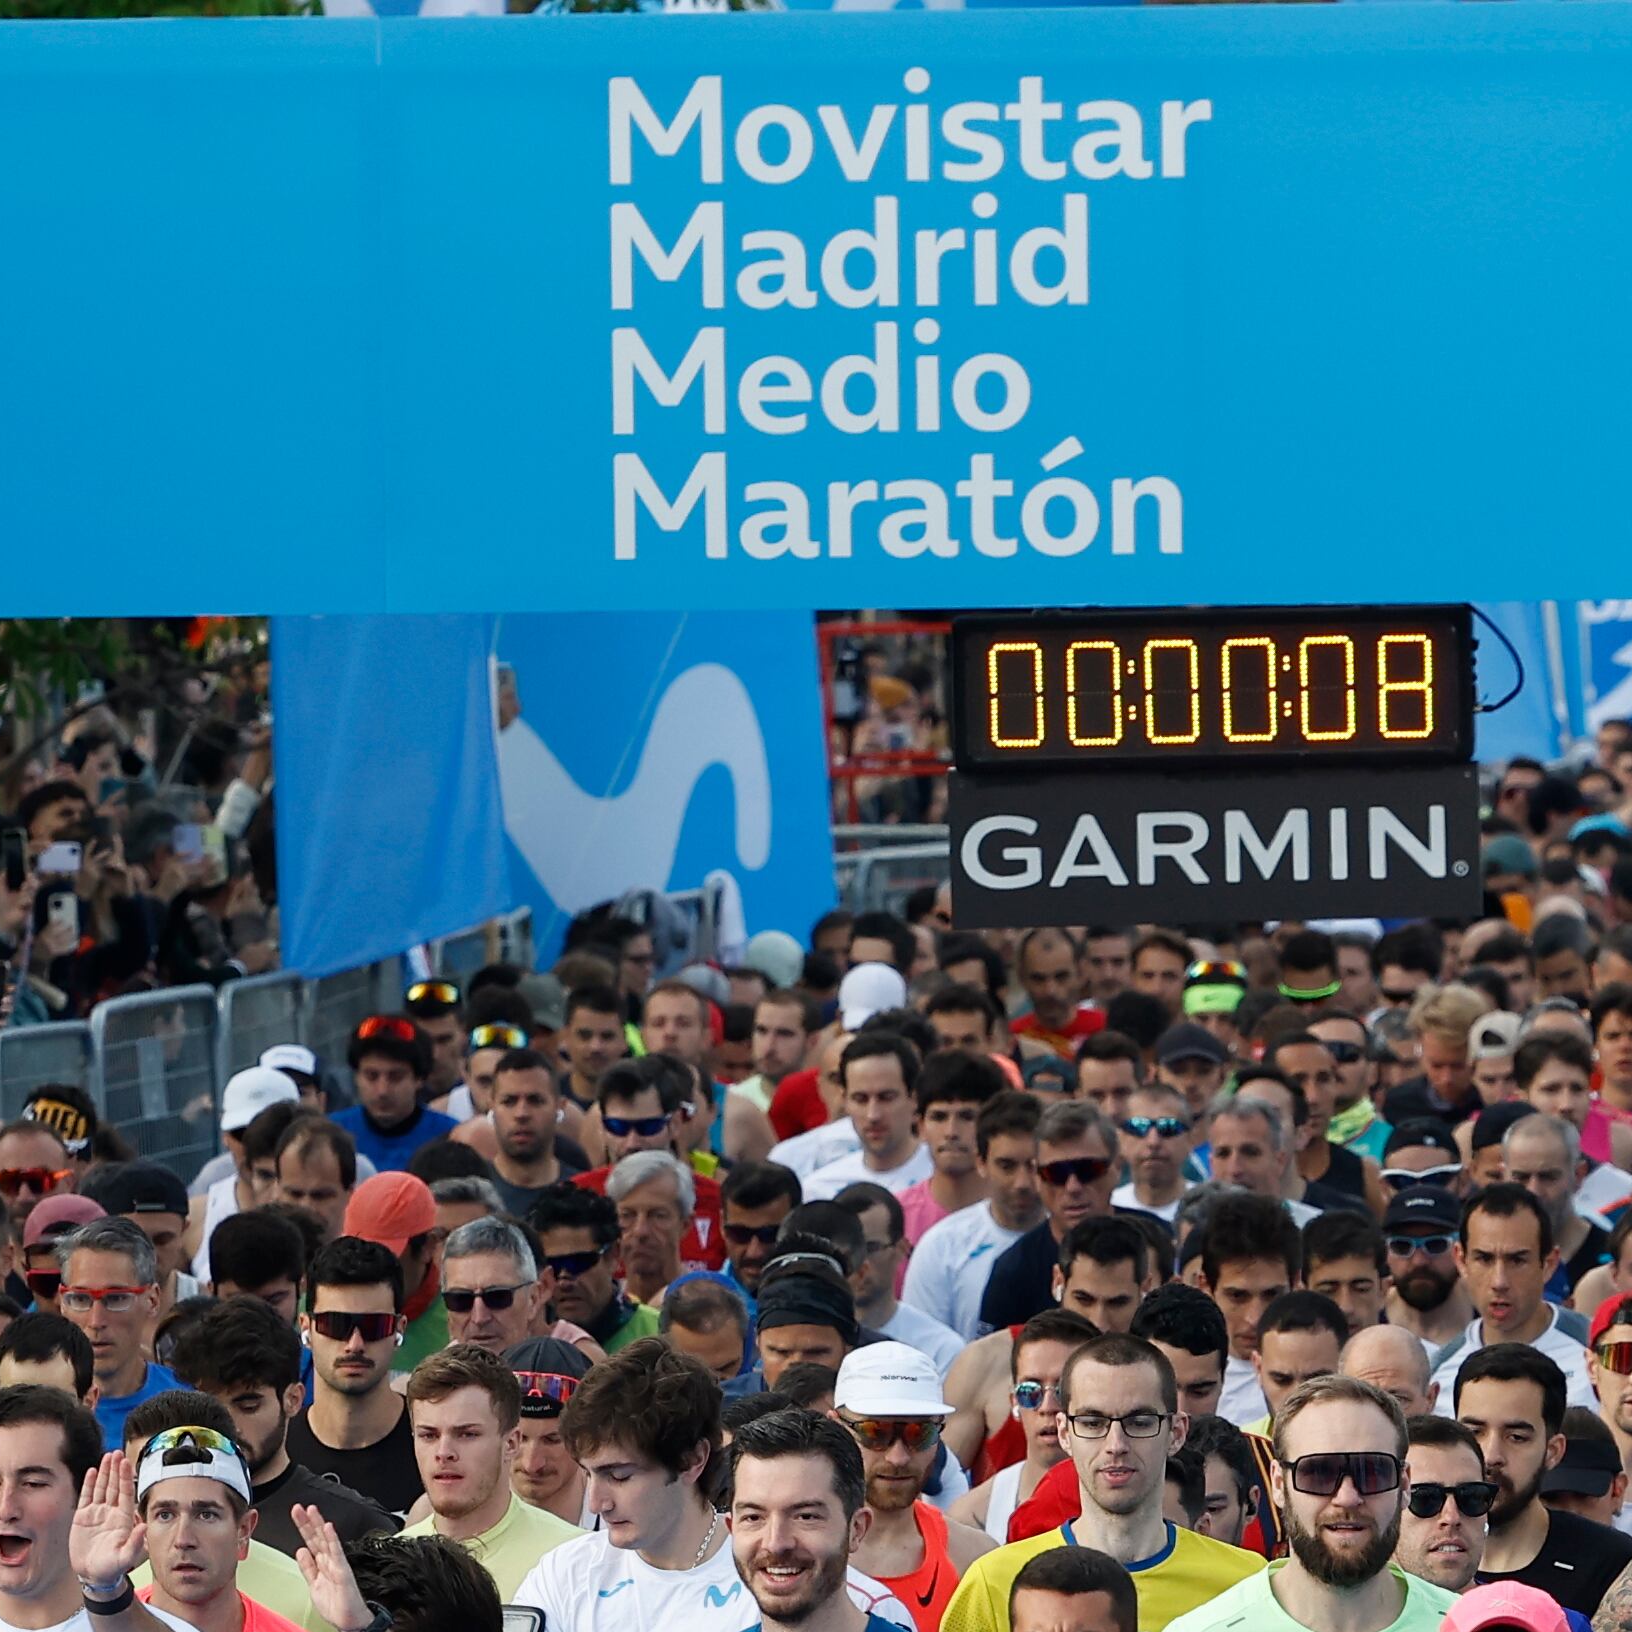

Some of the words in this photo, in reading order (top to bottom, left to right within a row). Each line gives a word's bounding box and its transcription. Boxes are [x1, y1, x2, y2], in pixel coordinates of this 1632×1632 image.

[608, 67, 1212, 185] Movistar
[610, 193, 1090, 309] Madrid
[611, 318, 1031, 435] Medio
[613, 436, 1183, 560] Maratón
[988, 633, 1433, 748] 00:00:08
[961, 803, 1448, 890] GARMIN
